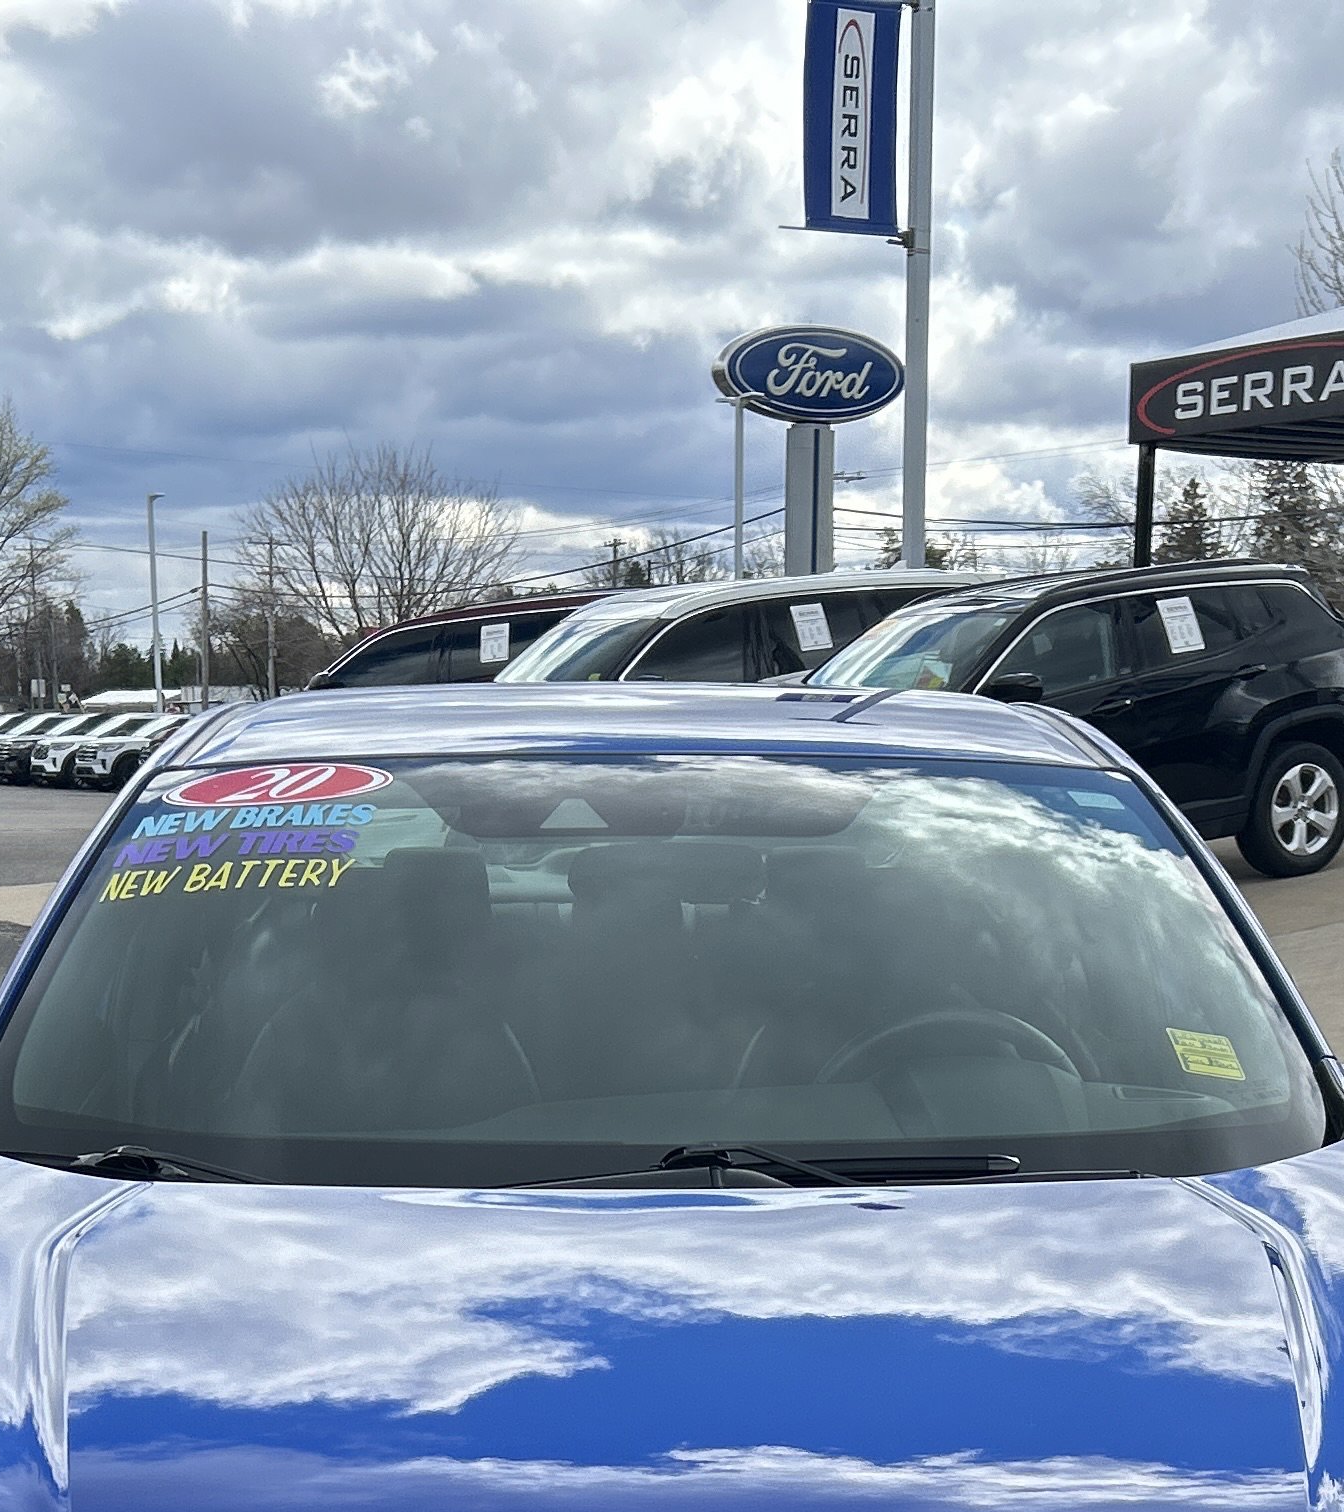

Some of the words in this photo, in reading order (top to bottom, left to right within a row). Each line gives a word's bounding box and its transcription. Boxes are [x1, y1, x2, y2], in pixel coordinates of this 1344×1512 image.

[838, 53, 861, 204] SERRA
[766, 342, 874, 401] Ford
[216, 765, 338, 805] 20
[132, 808, 231, 840] NEW
[229, 803, 378, 830] BRAKES
[113, 832, 230, 868] NEW
[239, 828, 361, 855] TIRES
[99, 865, 184, 904] NEW
[182, 858, 357, 894] BATTERY
